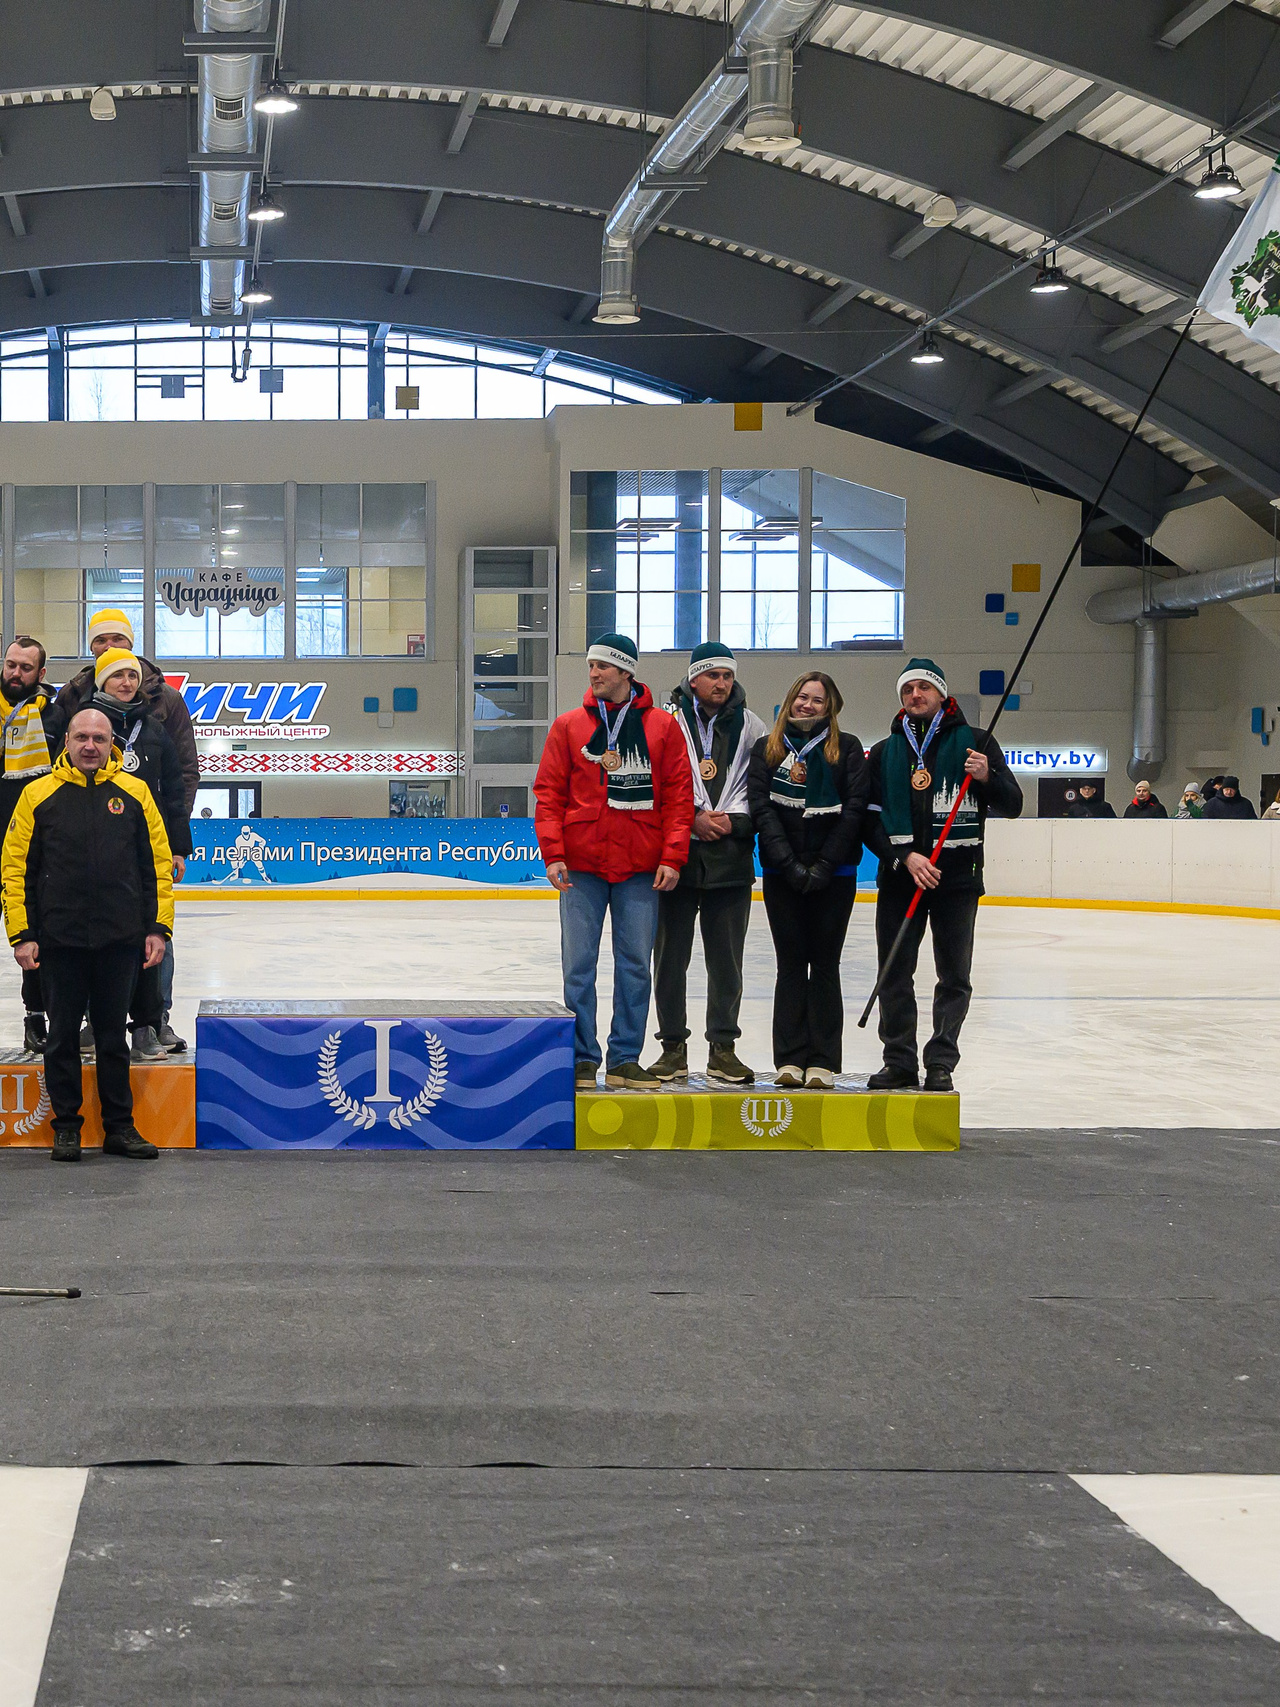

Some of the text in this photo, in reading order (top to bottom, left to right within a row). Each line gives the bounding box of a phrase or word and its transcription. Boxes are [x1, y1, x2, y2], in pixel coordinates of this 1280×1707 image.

[199, 573, 243, 583] КАФЕ
[162, 581, 280, 612] Чараўніца
[166, 674, 325, 721] ИЧИ
[194, 726, 327, 739] НОЛЫЖНЫЙ ЦЕНТР
[1005, 750, 1096, 768] ilichy.by
[211, 846, 294, 866] делами
[300, 841, 432, 867] Президента
[438, 841, 543, 867] Республи
[749, 1099, 785, 1123] III
